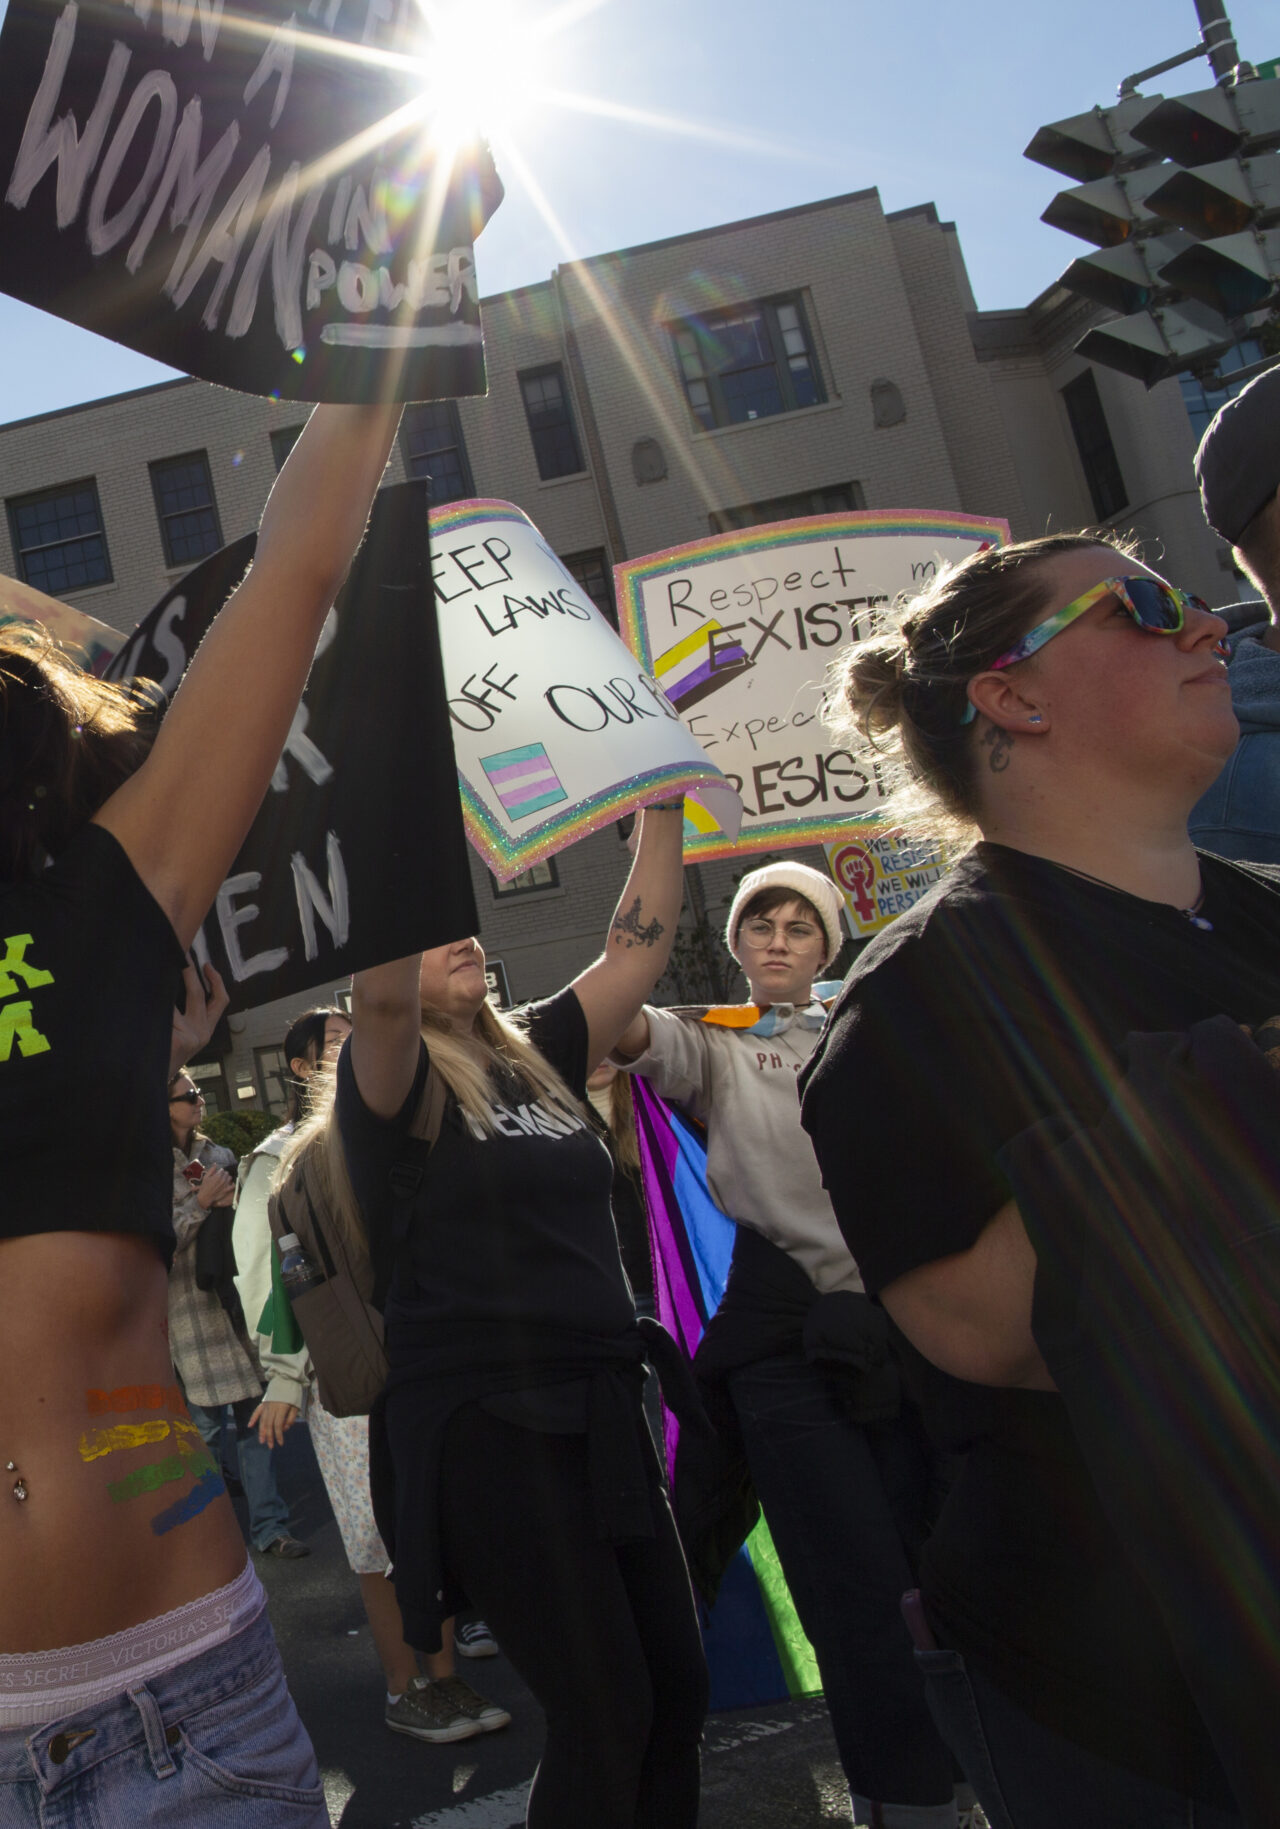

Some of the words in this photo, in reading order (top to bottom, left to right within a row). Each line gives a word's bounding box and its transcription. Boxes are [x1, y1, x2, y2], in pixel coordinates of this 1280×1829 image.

[5, 1, 328, 350] WOMAN
[328, 167, 394, 255] IN
[307, 247, 480, 314] POWER
[431, 537, 513, 604] EEP
[667, 546, 856, 627] Respect
[474, 588, 591, 637] LAWS
[448, 662, 519, 732] OFF
[544, 677, 658, 732] OUR
[686, 700, 828, 750] Expec
[877, 877, 902, 896] WE
[22, 1660, 92, 1687] SECRET
[109, 1615, 209, 1667] VICTORIA'S
